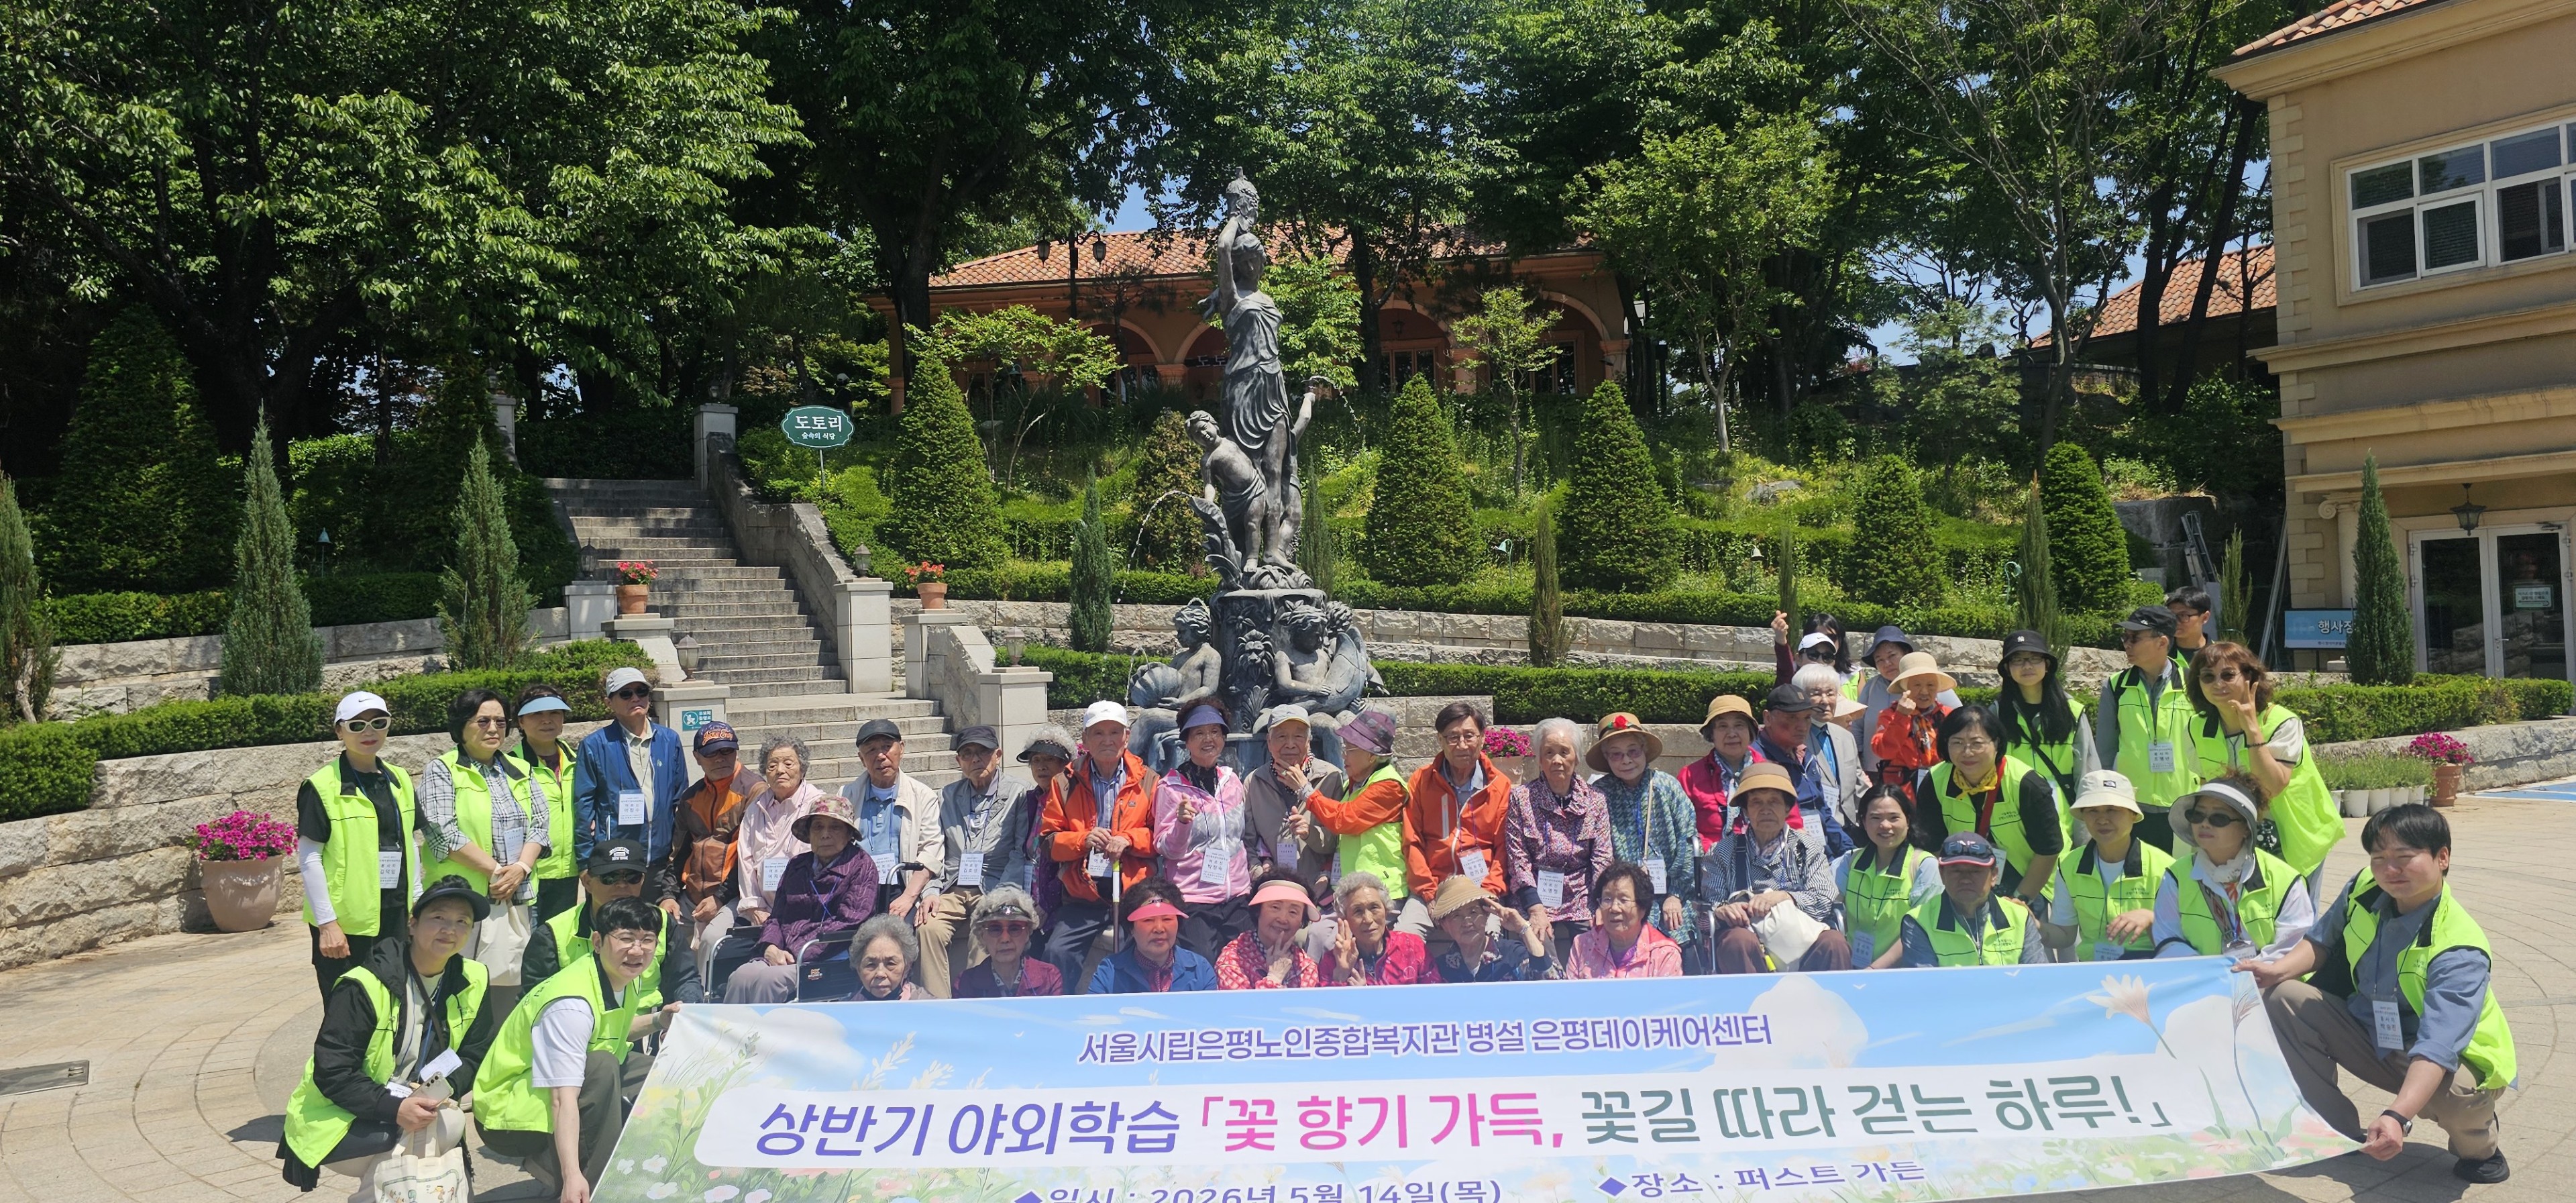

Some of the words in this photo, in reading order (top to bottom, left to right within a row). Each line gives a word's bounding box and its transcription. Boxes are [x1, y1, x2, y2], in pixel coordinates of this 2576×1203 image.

[794, 415, 842, 433] 도토리
[822, 433, 836, 441] 식당
[1079, 1024, 1460, 1063] 서울시립은평노인종합복지관
[1466, 1022, 1525, 1052] 병설
[1532, 1014, 1772, 1051] 은평데이케어센터
[756, 1103, 934, 1156] 상반기
[949, 1100, 1180, 1155] 야외학습
[1202, 1096, 1278, 1152] 「꽃
[1297, 1095, 1408, 1150] 향기
[1429, 1093, 1563, 1148] 가득,
[1581, 1088, 1701, 1144] 꽃길
[1713, 1085, 1836, 1139] 따라
[1847, 1084, 1978, 1135] 걷는
[1986, 1076, 2173, 1131] 하루!」
[1631, 1172, 1704, 1198] 장소
[1733, 1164, 1845, 1191] 퍼스트
[1851, 1160, 1925, 1183] 가든
[1290, 1184, 1342, 1203] 5월
